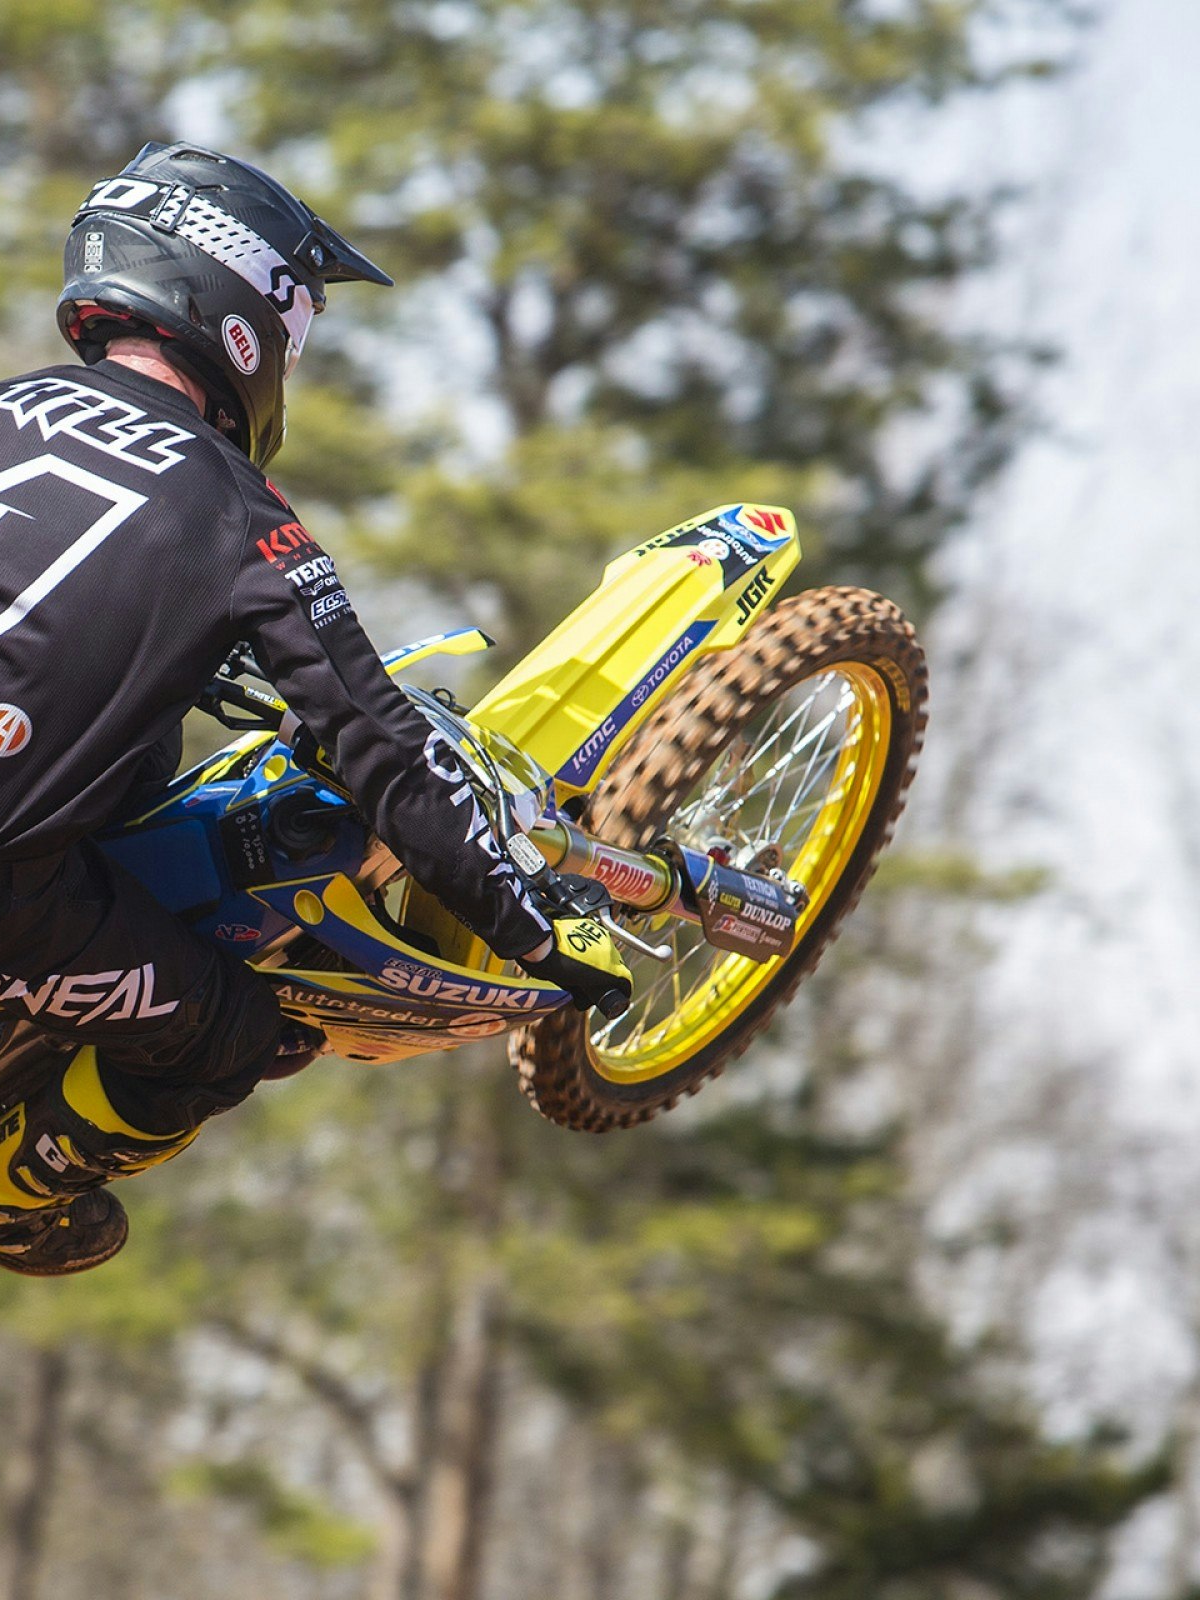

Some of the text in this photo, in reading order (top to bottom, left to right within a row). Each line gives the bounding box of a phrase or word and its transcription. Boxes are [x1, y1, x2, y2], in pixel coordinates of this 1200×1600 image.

[228, 322, 255, 368] BELL
[736, 565, 776, 626] JGR
[647, 636, 694, 687] TOYOTA
[572, 717, 617, 770] KMC
[741, 901, 792, 931] DUNLOP
[275, 985, 446, 1027] Autotrader
[378, 968, 541, 1009] SUZUKI
